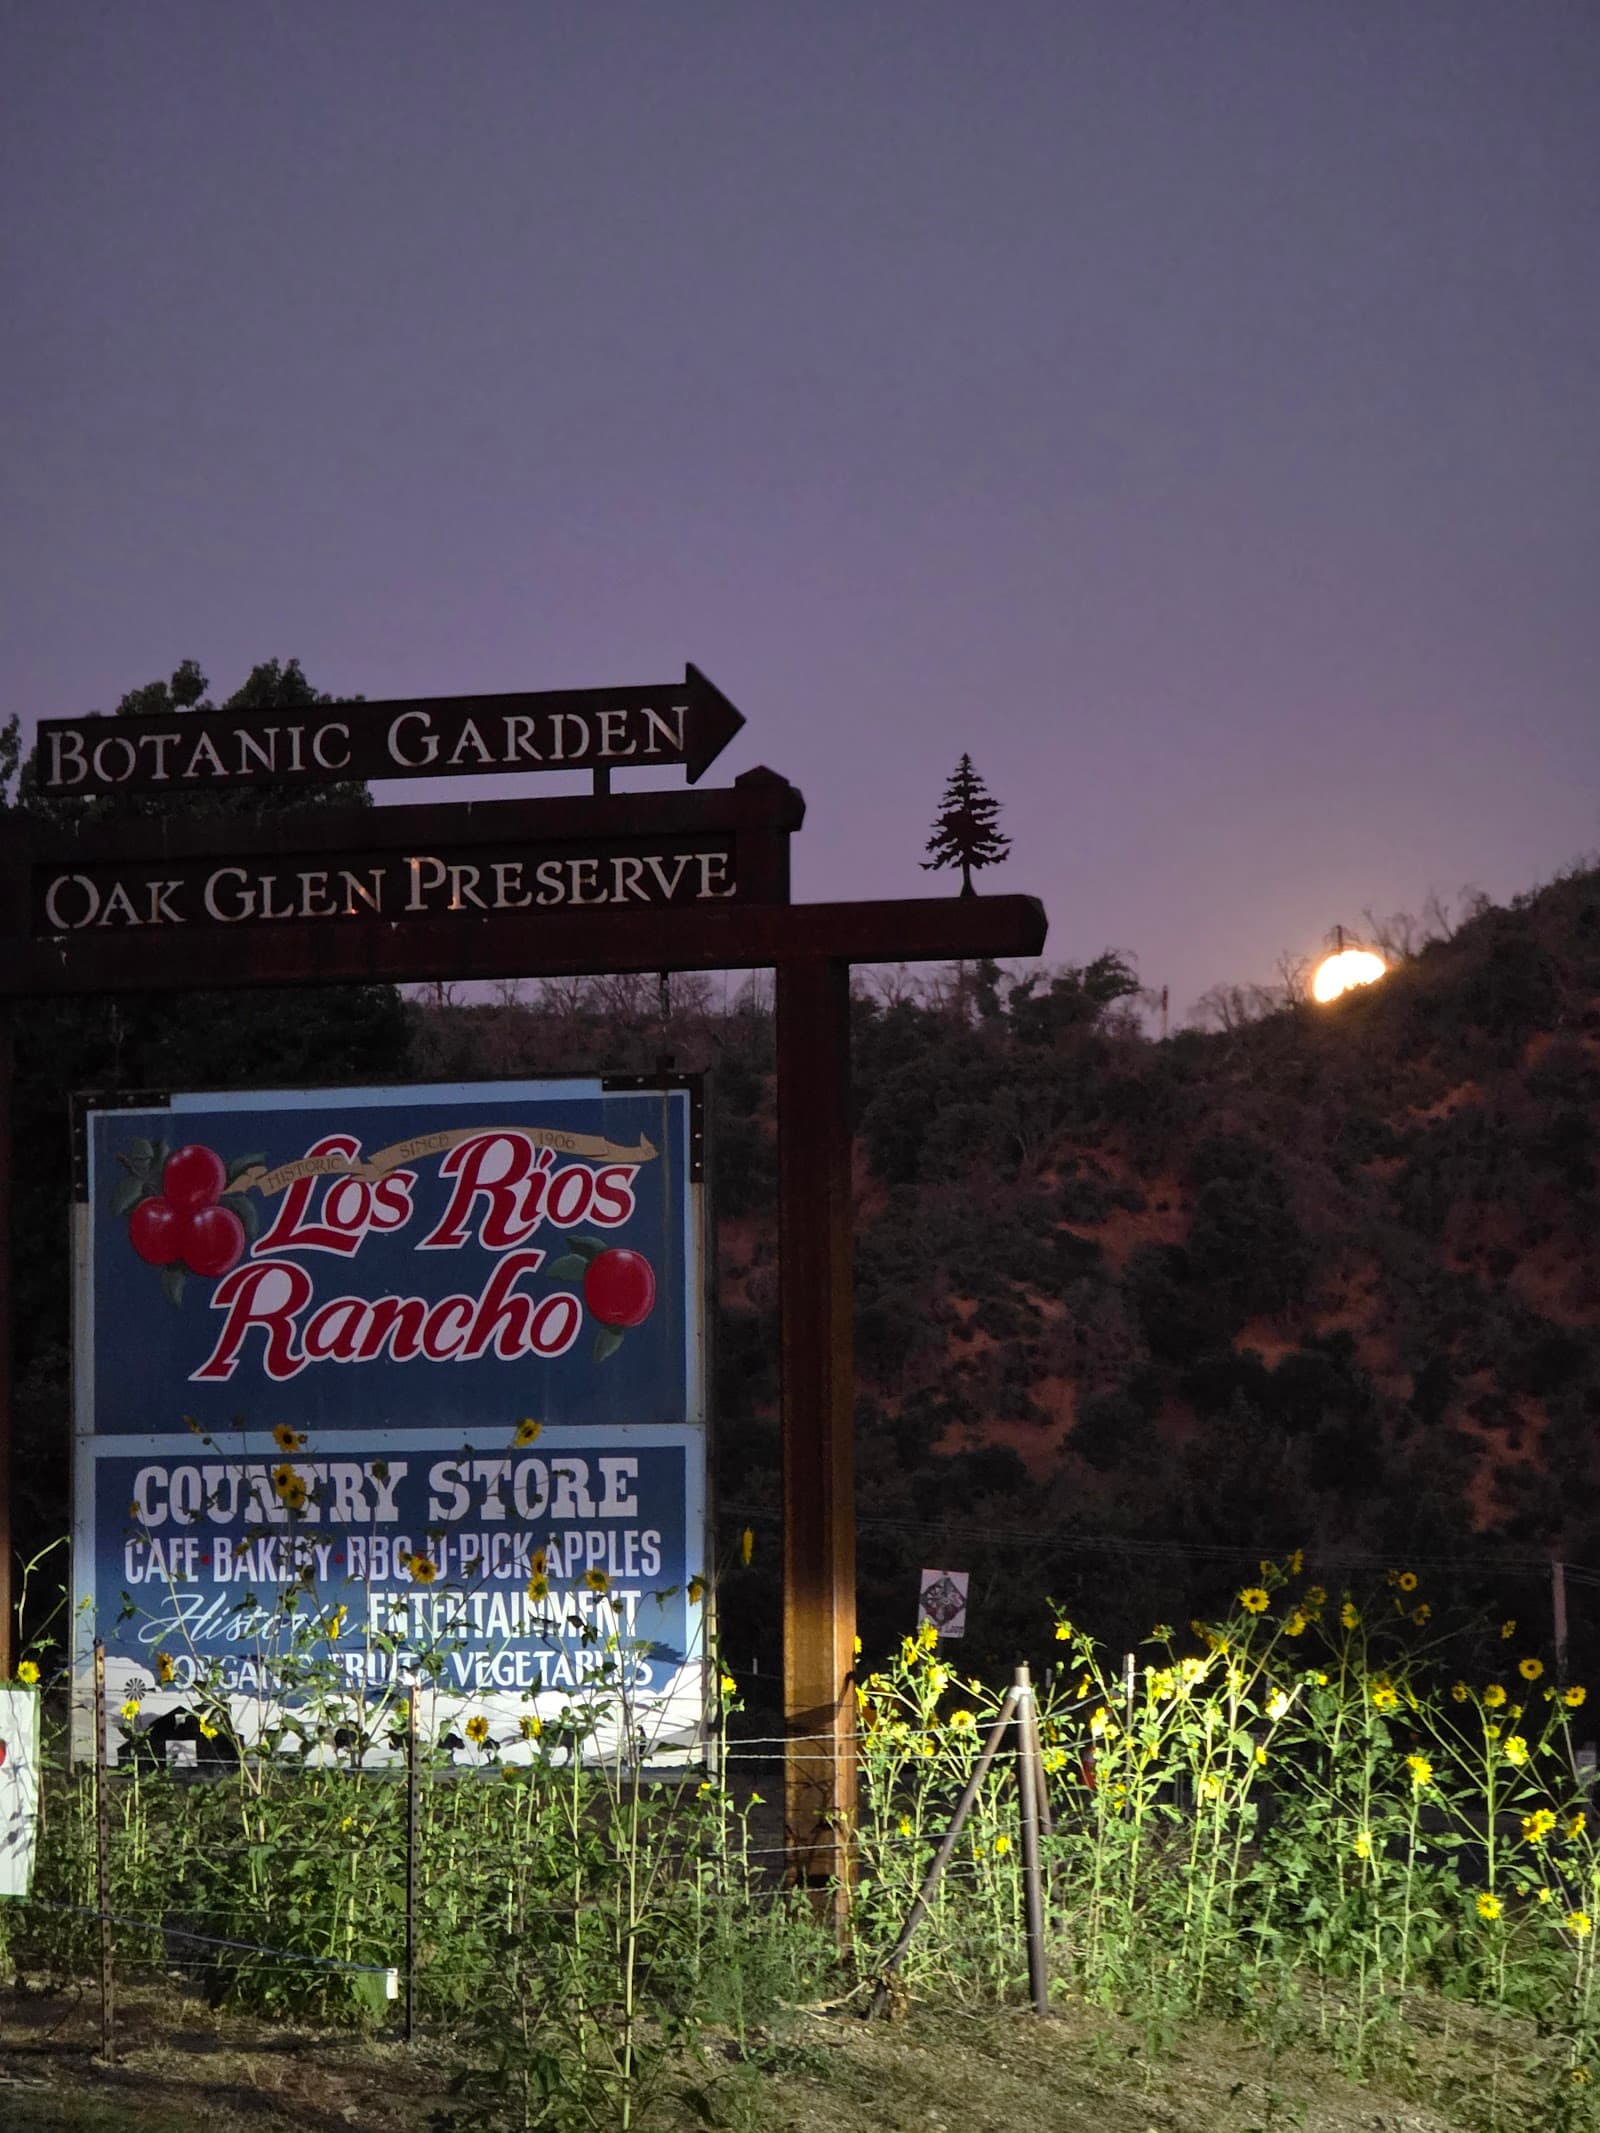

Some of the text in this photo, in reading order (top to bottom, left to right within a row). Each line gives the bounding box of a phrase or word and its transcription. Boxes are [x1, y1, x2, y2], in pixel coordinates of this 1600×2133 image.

[46, 705, 689, 787] BOTANIC GARDEN
[46, 851, 737, 929] OAK GLEN PRESERVE
[266, 1131, 576, 1186] HISTORIC SINCE 1906
[251, 1134, 419, 1257] Los
[188, 1249, 582, 1381] Rancho
[133, 1457, 638, 1526] COUNTRY STORE
[125, 1537, 199, 1584] CAFE
[347, 1535, 413, 1583] BBQ
[544, 1530, 661, 1578] APPLES
[370, 1590, 642, 1638] ENTERTAINMENT
[328, 1652, 418, 1688] RUT
